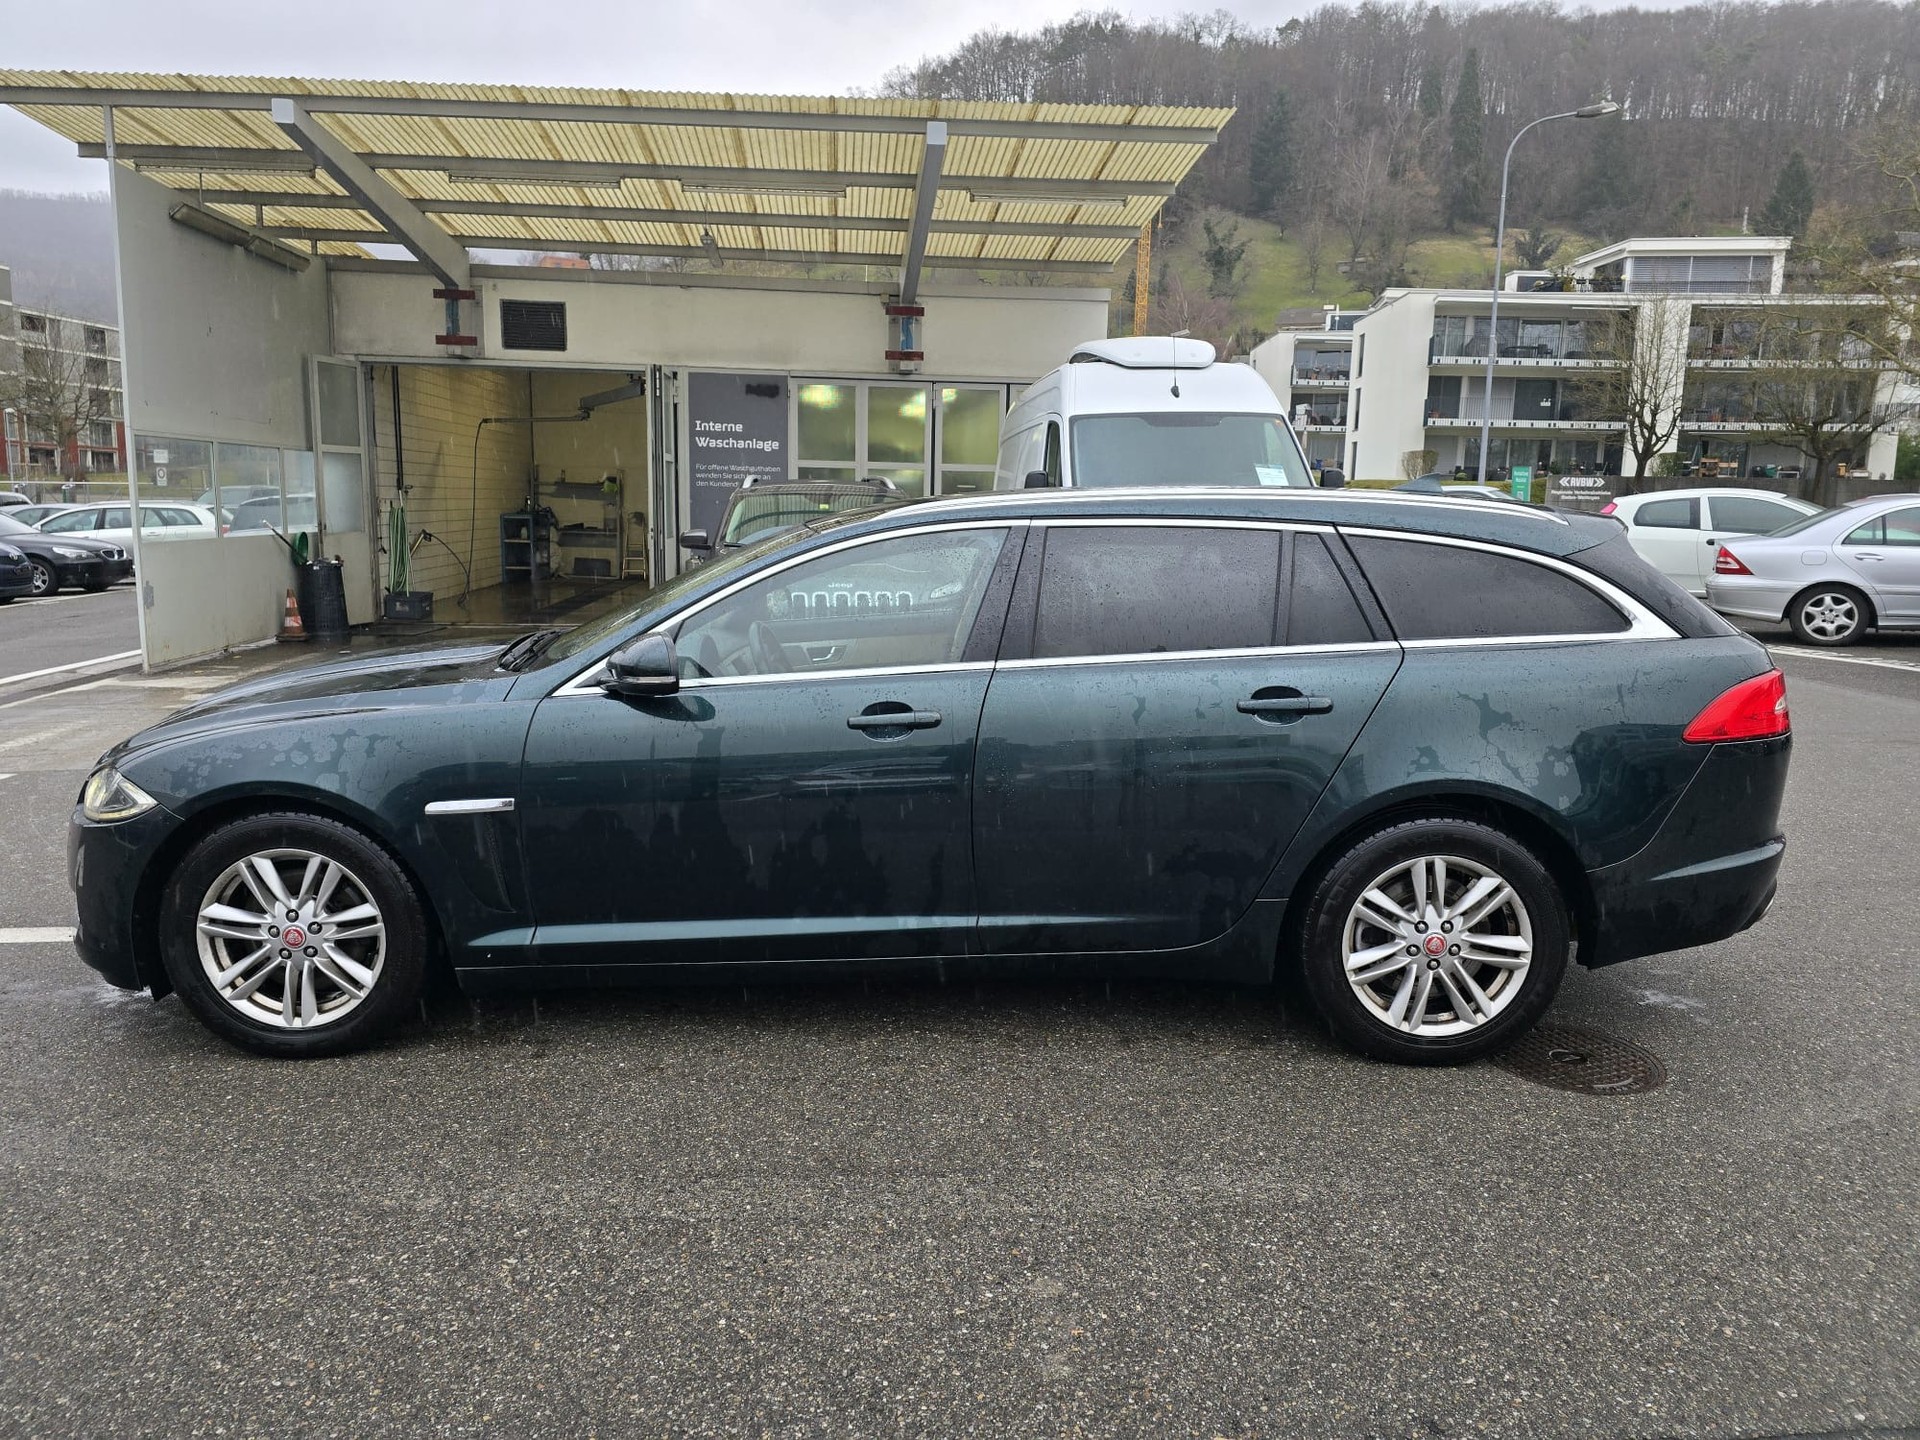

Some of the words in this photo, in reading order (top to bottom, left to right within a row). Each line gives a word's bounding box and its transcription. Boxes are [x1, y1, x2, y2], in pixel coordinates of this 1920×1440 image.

[695, 420, 743, 432] Interne
[695, 436, 780, 452] Waschanlage
[708, 463, 729, 471] offene
[730, 464, 781, 473] Waschguthaben
